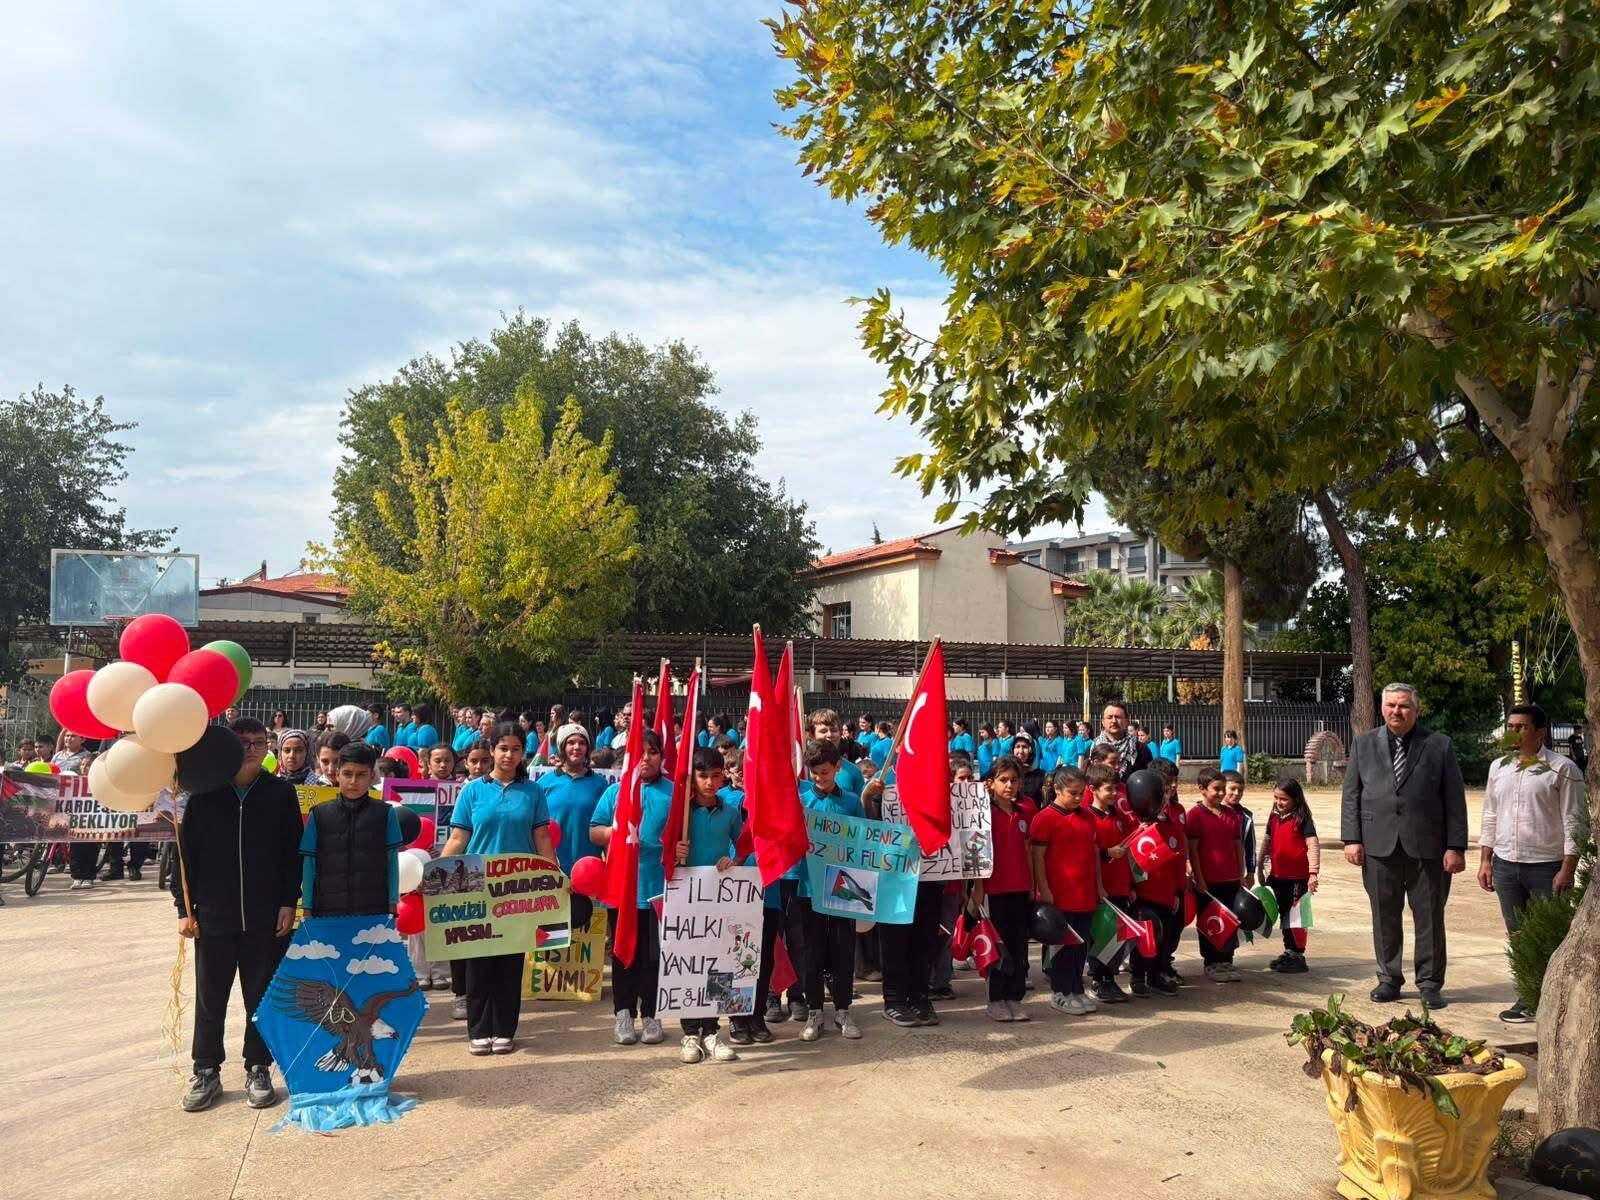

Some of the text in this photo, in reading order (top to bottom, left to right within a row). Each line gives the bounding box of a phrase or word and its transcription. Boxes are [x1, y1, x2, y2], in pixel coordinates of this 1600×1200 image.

[69, 813, 139, 830] BEKLİYOR
[664, 876, 764, 904] FILISTIN
[663, 915, 722, 941] HALKI
[661, 951, 719, 977] YANLIZ
[531, 967, 600, 994] EVİMİZ
